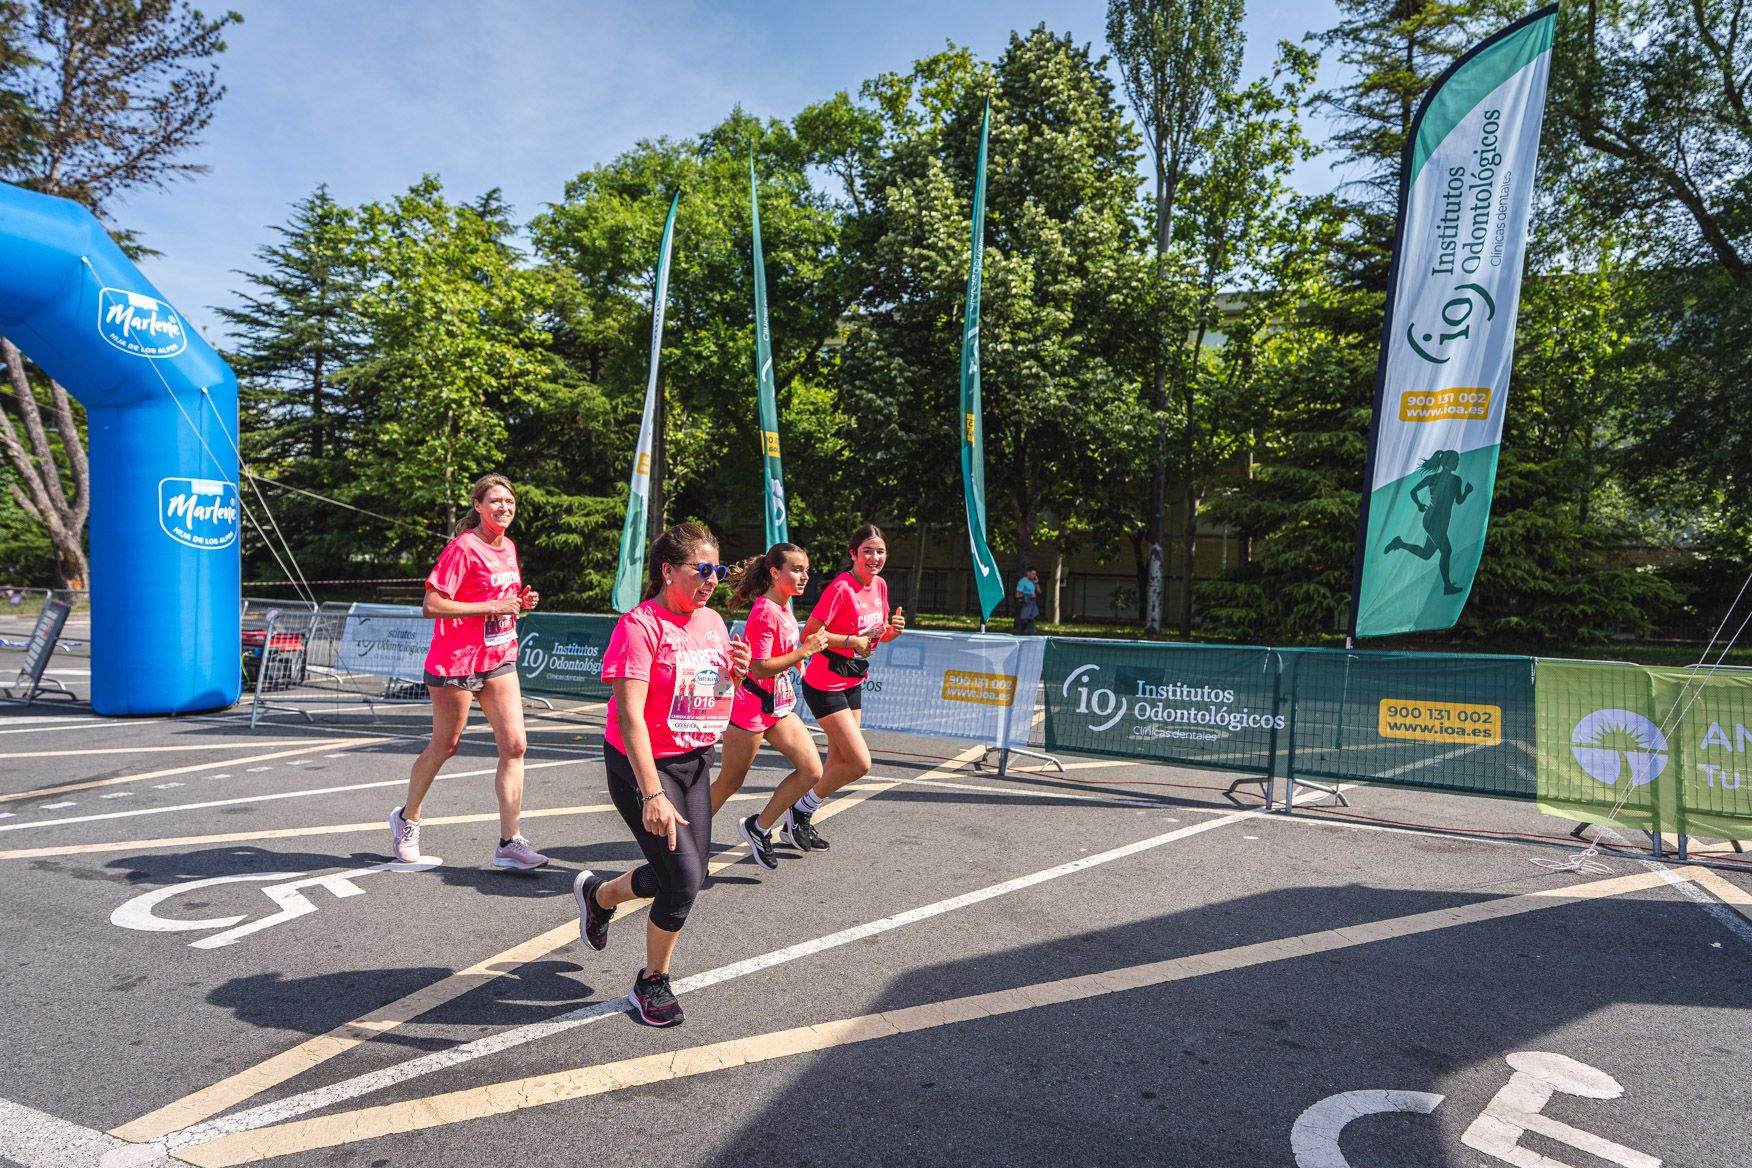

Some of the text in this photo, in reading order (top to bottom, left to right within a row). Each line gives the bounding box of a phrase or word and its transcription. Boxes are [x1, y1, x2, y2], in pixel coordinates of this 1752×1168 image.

[1461, 109, 1502, 274] Odontológicos
[1432, 166, 1466, 276] Institutos
[1490, 170, 1512, 267] Clínicas dentales
[106, 303, 181, 338] Marlene
[1407, 392, 1487, 407] 900 131 002
[1406, 404, 1485, 417] www.ioa.es
[167, 493, 236, 530] Marlene
[552, 642, 599, 657] Institutos
[549, 656, 604, 675] Odontológi
[1135, 680, 1235, 704] Institutos
[693, 696, 715, 708] 016
[1134, 702, 1286, 731] Odontológicos
[1387, 706, 1493, 724] 900 131 002
[1133, 725, 1218, 742] Clínicas dentales
[1388, 722, 1493, 738] www.ioa.es
